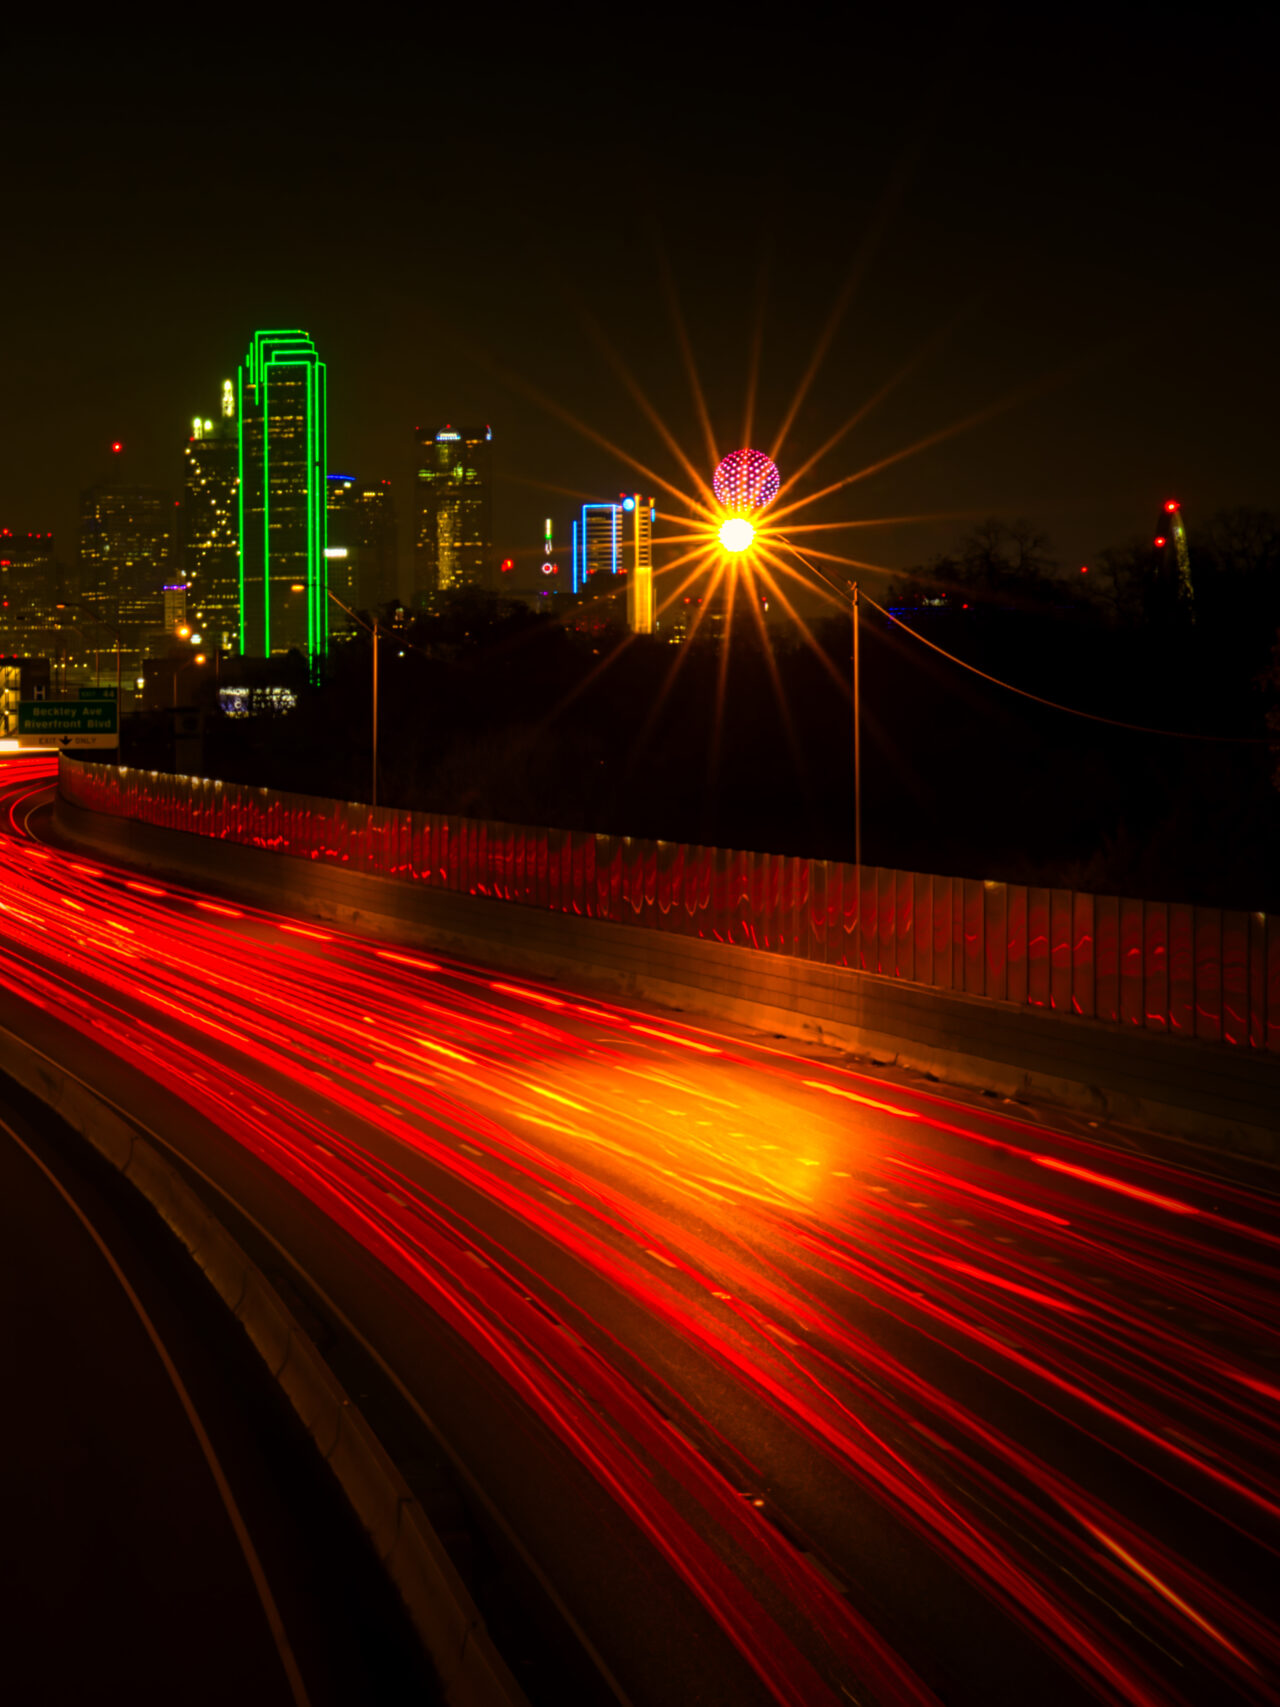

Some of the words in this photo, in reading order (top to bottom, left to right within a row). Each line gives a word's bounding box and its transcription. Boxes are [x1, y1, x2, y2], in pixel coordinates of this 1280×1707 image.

[33, 707, 77, 718] Beckley
[82, 707, 103, 716] Ave
[24, 719, 80, 728] Riverfront
[88, 719, 111, 728] Blvd
[38, 737, 56, 745] EXIT
[75, 737, 96, 745] ONLY
